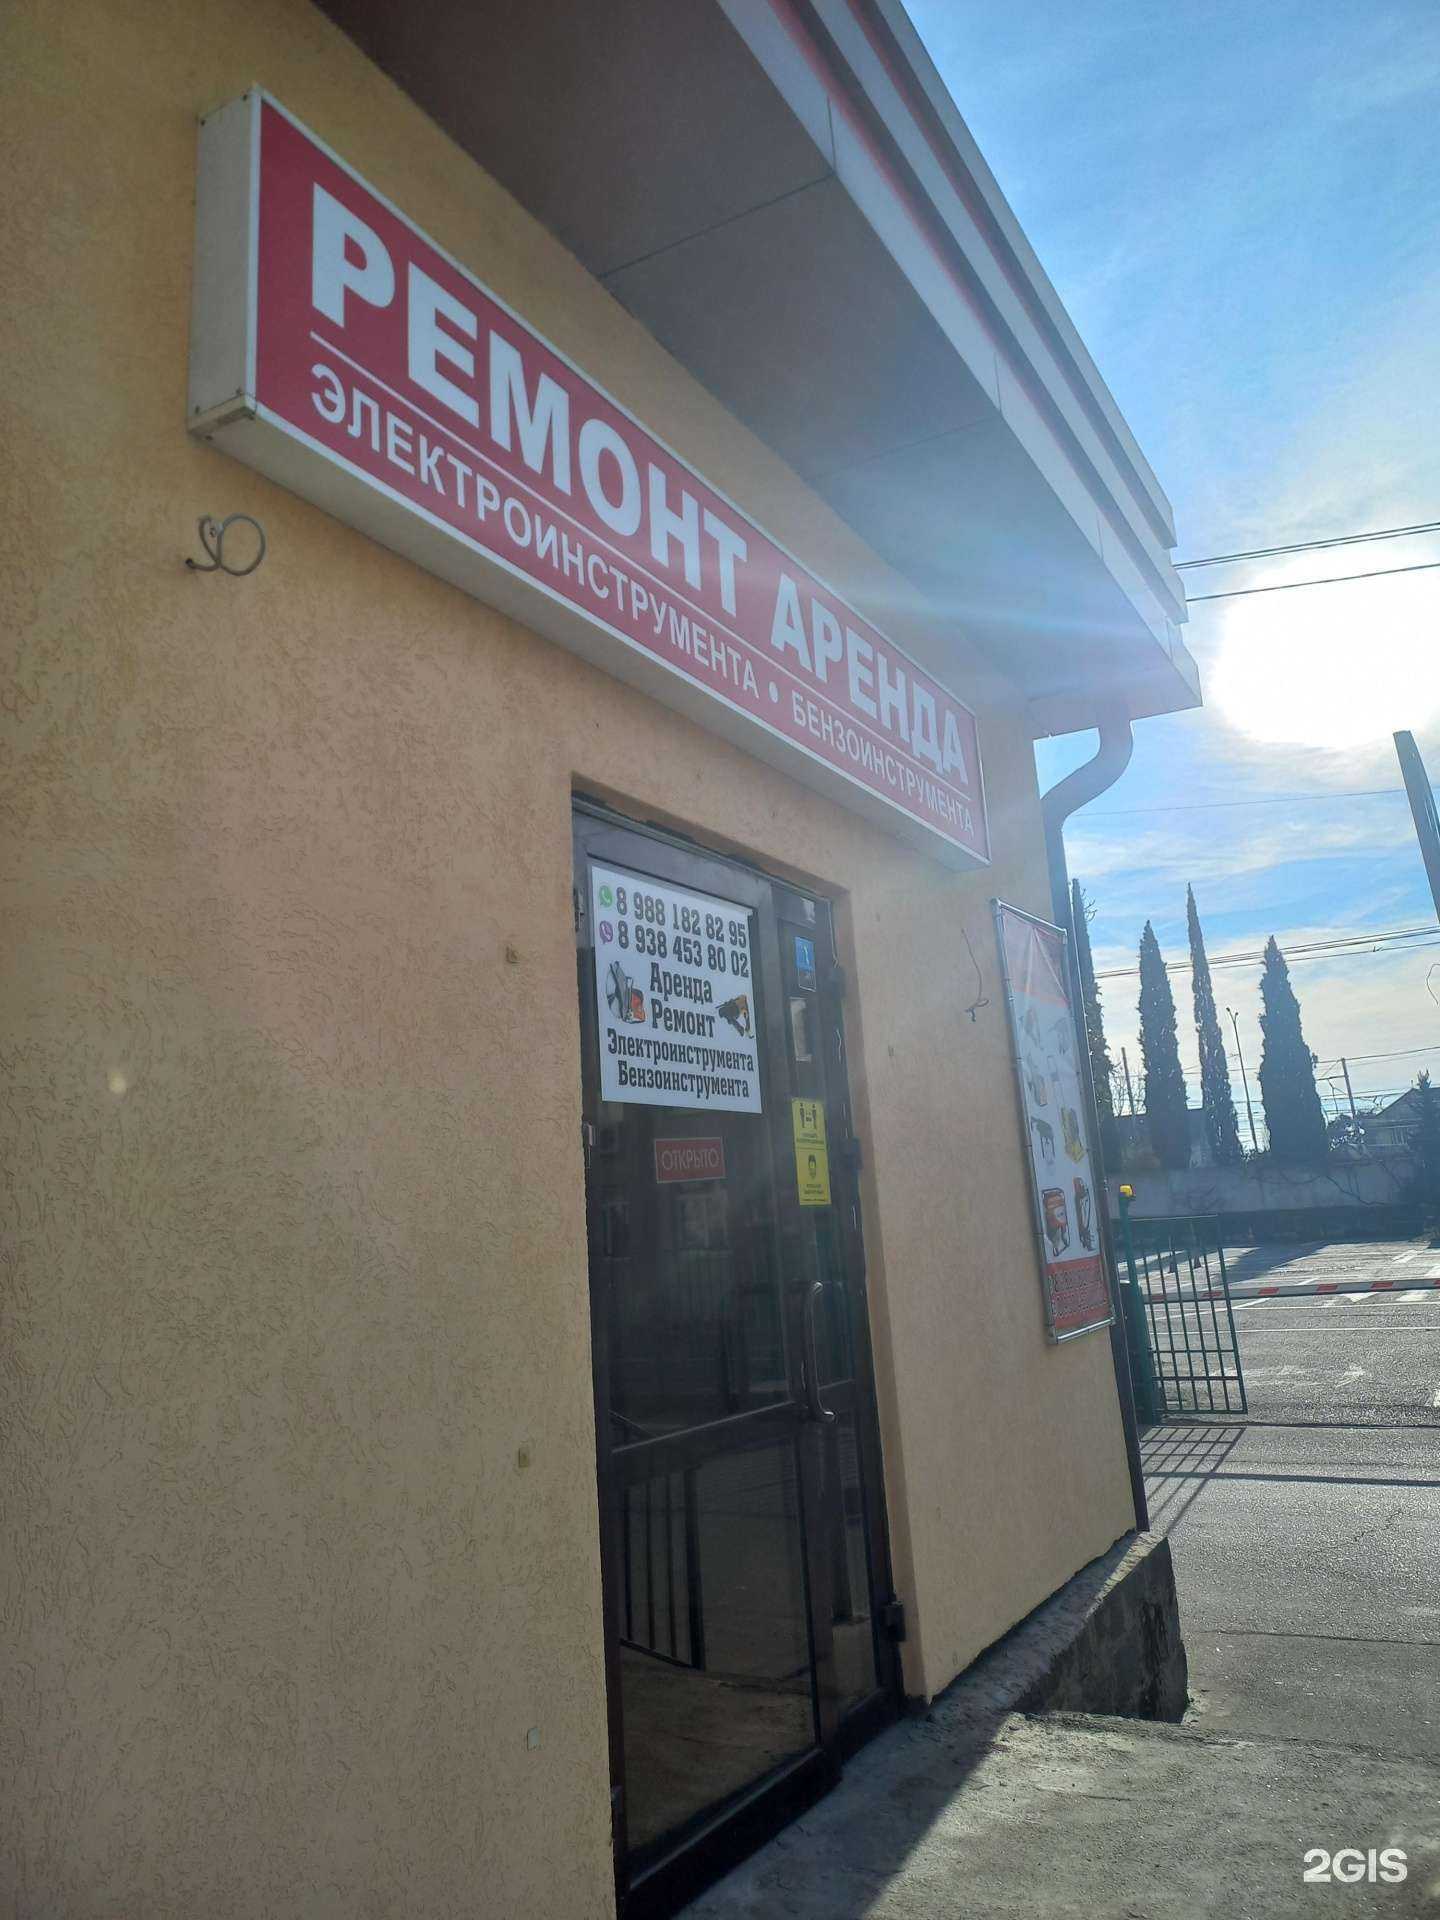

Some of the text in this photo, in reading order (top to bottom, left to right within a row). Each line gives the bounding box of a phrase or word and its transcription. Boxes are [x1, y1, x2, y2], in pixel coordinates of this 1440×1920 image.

[312, 182, 969, 785] РЕМОНТ АРЕНДА
[311, 364, 975, 837] ЭЛЕКТРОИНСТРУМЕНТА БЕНЗОИНСТРУМЕНТА
[616, 887, 747, 948] 8 988 182 82 95
[618, 920, 749, 978] 8 938 453 80 02
[650, 962, 713, 1004] Аренда
[651, 999, 716, 1039] Ремонт
[607, 1028, 754, 1072] Электроинструмента
[617, 1060, 750, 1100] Бензоинструмента
[661, 1147, 720, 1170] ОТКРЫТО
